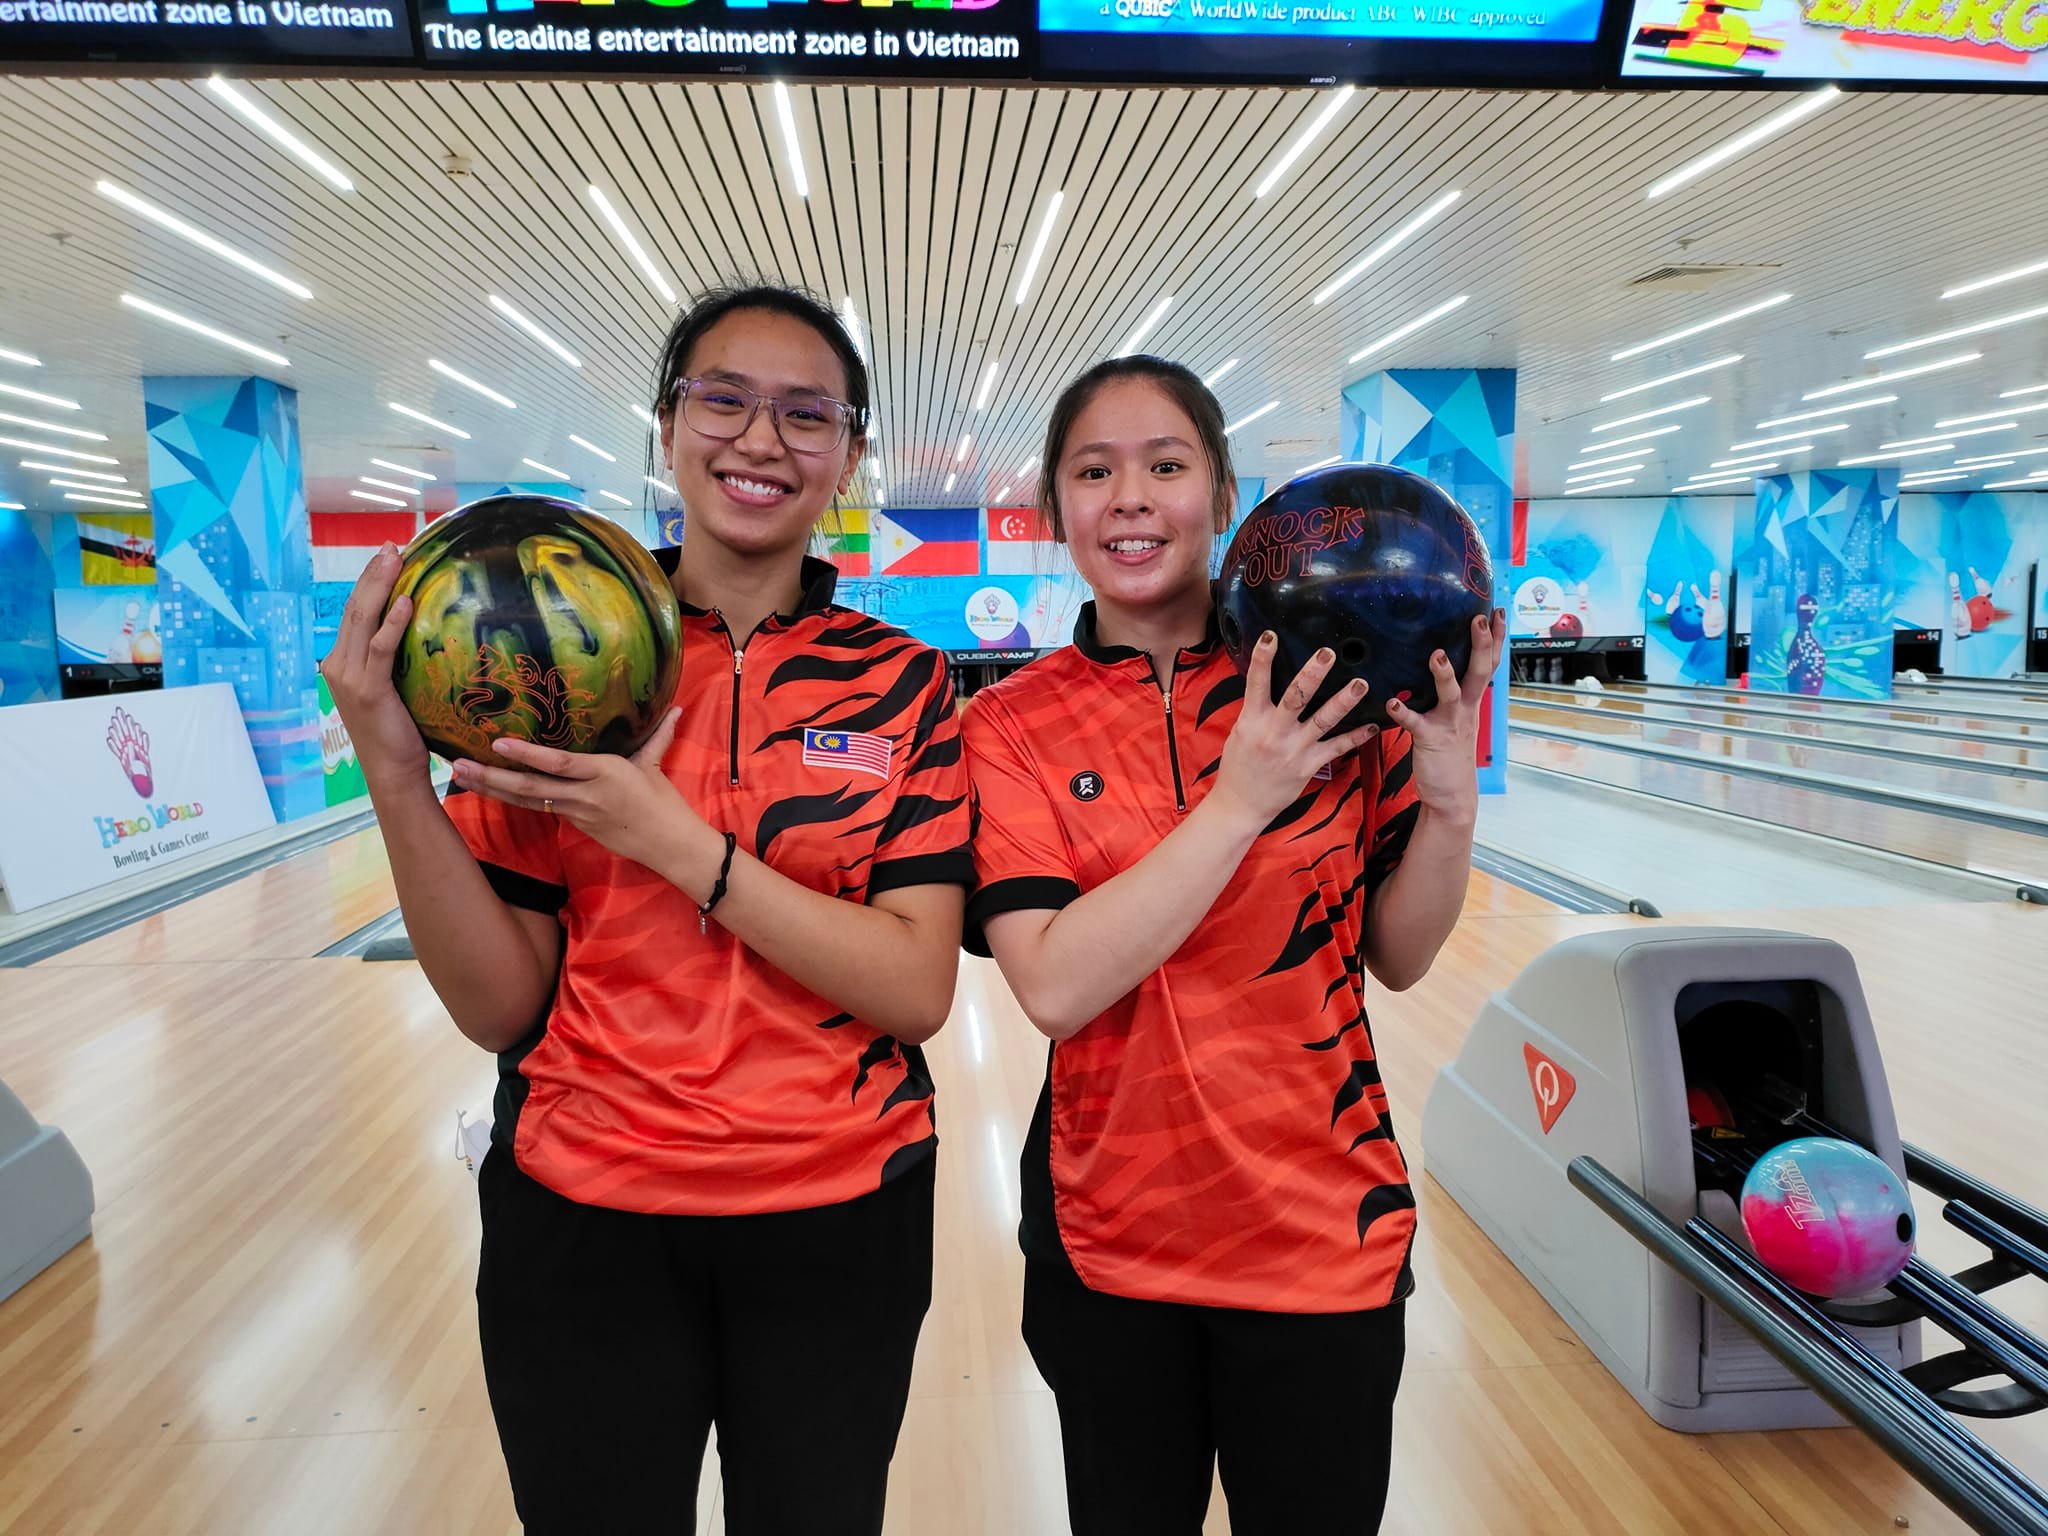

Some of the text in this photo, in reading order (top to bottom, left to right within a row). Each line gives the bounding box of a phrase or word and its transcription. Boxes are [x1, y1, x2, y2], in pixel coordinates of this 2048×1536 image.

[165, 3, 232, 25] zone
[239, 1, 267, 26] in
[272, 1, 394, 28] Vietnam
[1293, 3, 1356, 24] product
[1470, 7, 1545, 28] approved
[424, 23, 1020, 58] The leading entertainment zone in Vietnam
[1231, 506, 1366, 573] KNOCK
[1243, 540, 1325, 588] OUT
[1631, 637, 1644, 648] 12
[1926, 631, 1940, 641] 14
[2036, 629, 2048, 640] 15
[66, 666, 73, 678] 1
[93, 802, 204, 849] HERO WORLD
[112, 830, 210, 869] Bowling & Games Center
